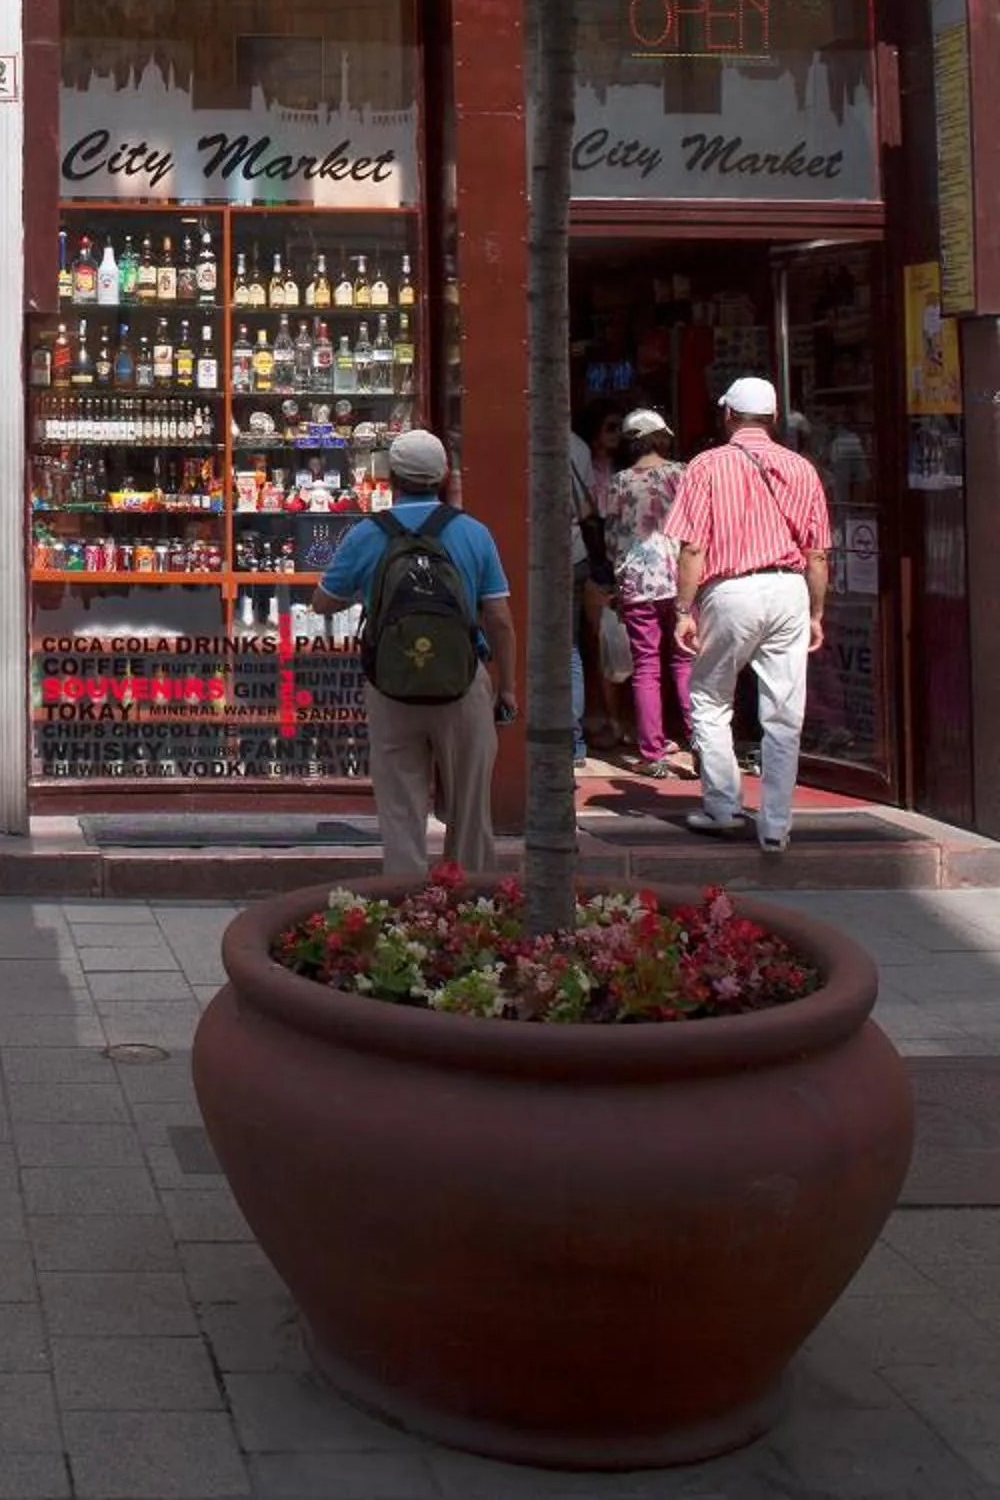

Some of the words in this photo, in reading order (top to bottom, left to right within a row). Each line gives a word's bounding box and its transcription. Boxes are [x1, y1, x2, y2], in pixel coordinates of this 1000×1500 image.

[60, 128, 174, 187] City
[197, 131, 395, 183] Market
[571, 128, 663, 179] City
[681, 131, 844, 180] Market
[42, 636, 104, 653] COCA
[111, 636, 172, 653] COLA
[175, 635, 277, 655] DRINKS
[43, 657, 146, 676] COFFEE
[41, 675, 226, 702] SOUVENIRS
[233, 681, 276, 699] GIN
[42, 702, 133, 721] TOKAY
[149, 704, 219, 716] MINERAL
[224, 704, 278, 716] WATER
[42, 723, 106, 738] CHIPS
[111, 722, 238, 738] CHOCOLATE
[42, 741, 163, 761] WHISKY
[178, 760, 258, 777] VODKA
